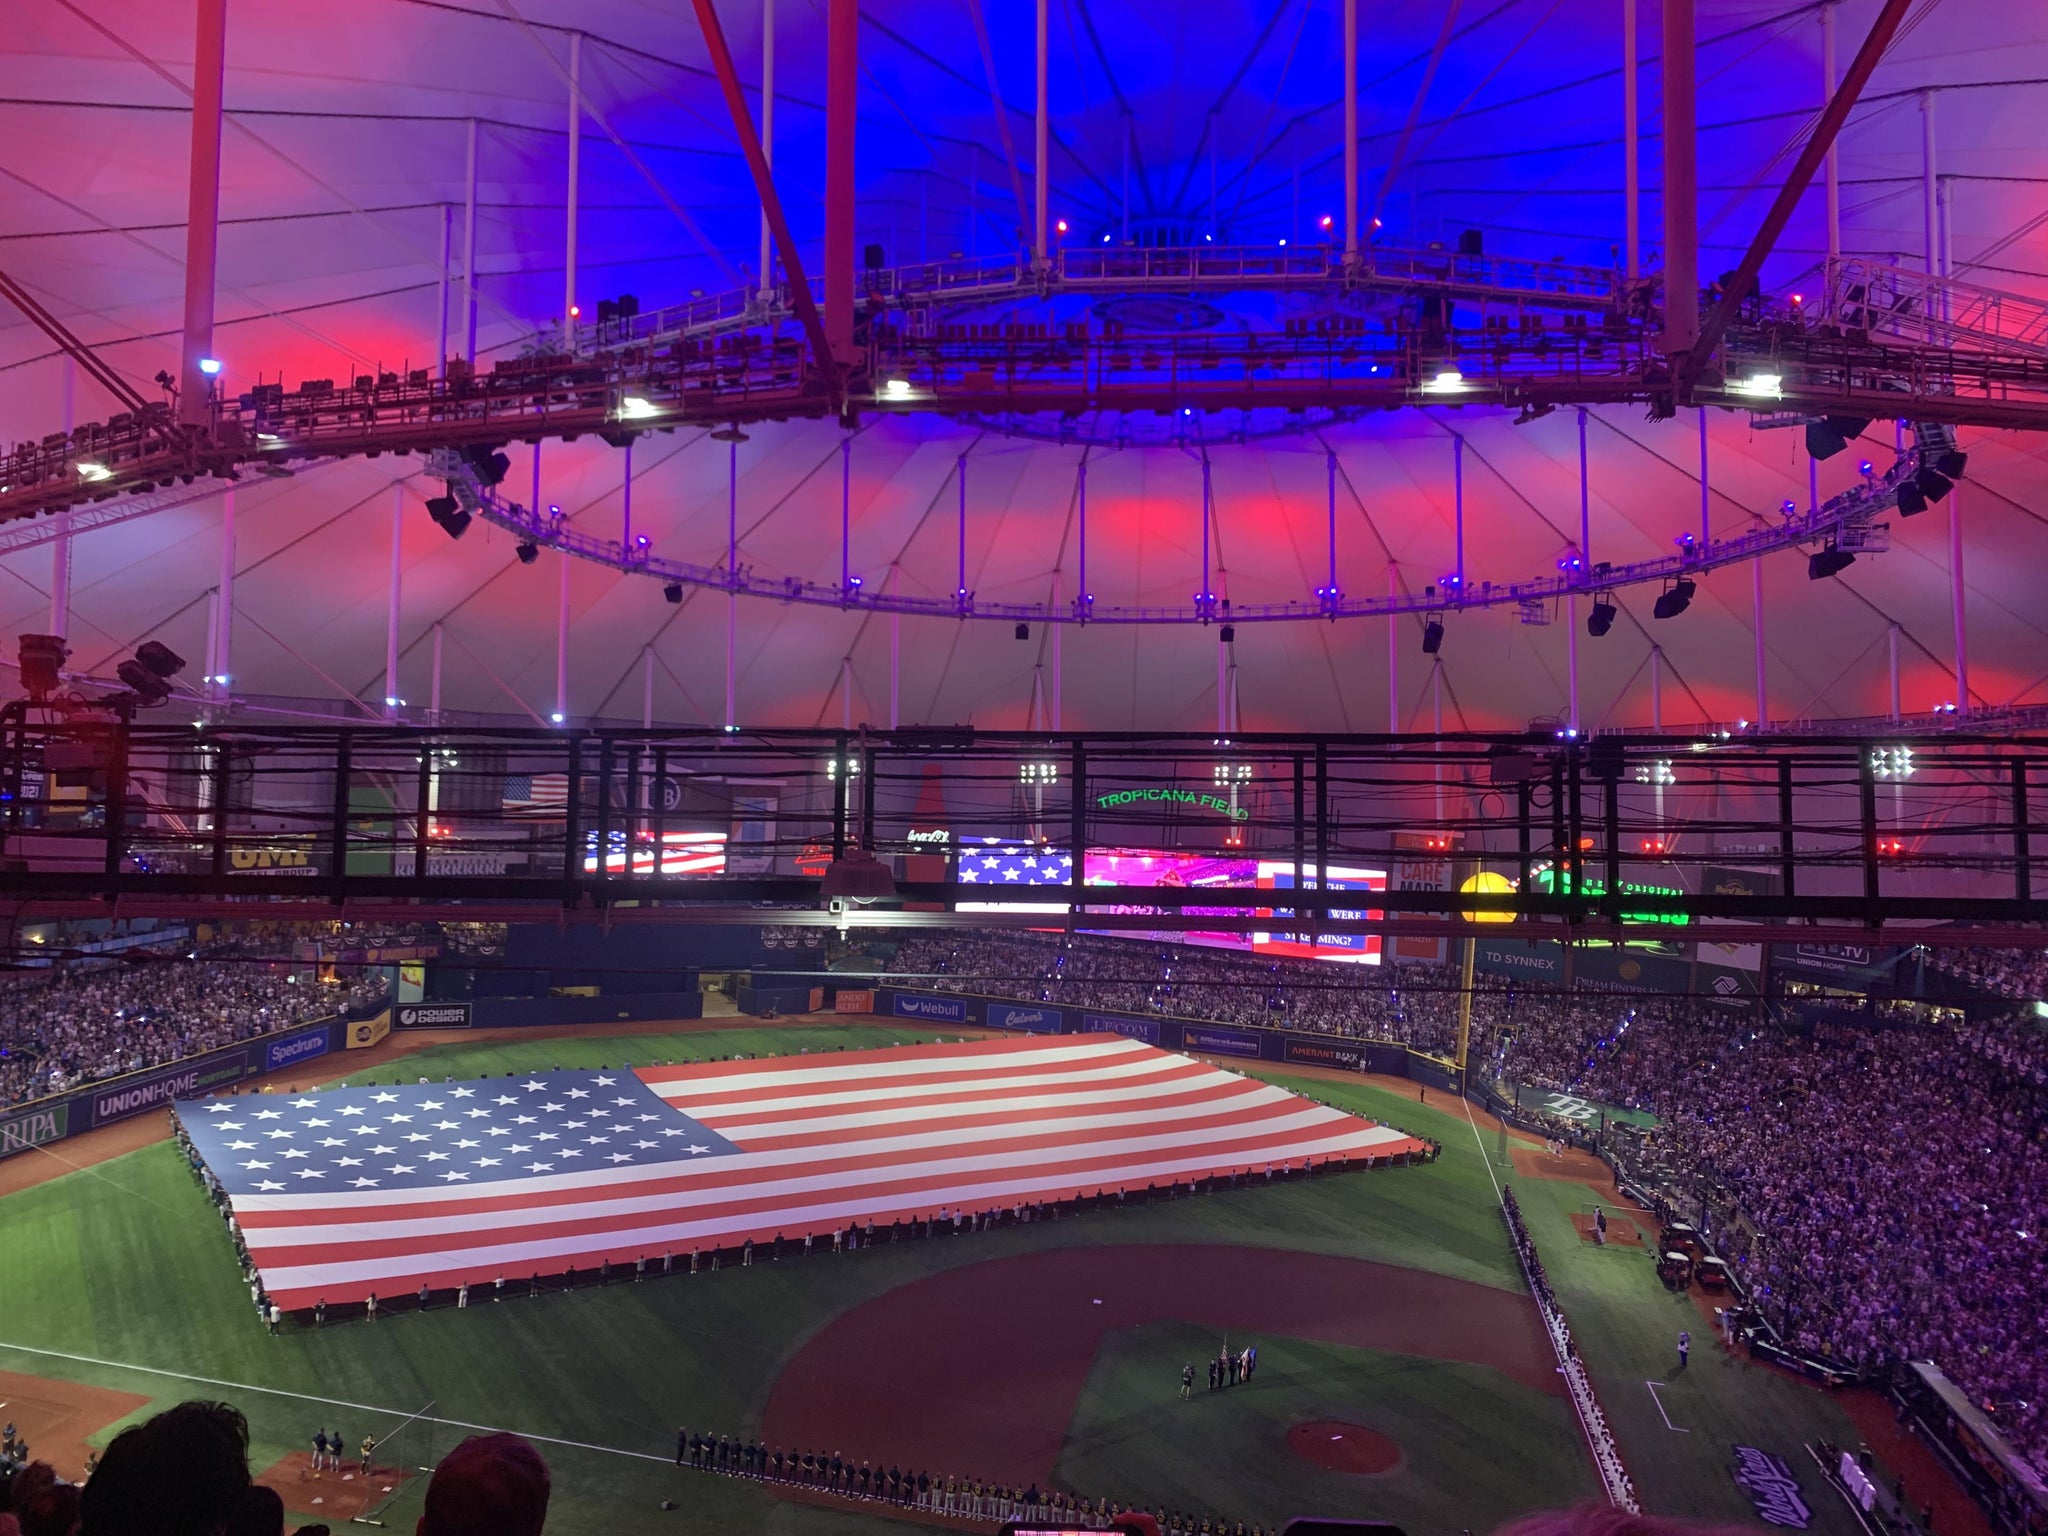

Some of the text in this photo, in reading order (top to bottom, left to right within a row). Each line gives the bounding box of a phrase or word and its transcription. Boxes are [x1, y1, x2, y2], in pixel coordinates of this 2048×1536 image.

[1098, 789, 1248, 820] TROPICANA FIELD
[1401, 863, 1444, 882] CARE
[1486, 951, 1554, 970] TD SYNNEX
[1796, 958, 1823, 968] UNION
[1823, 963, 1847, 972] HOME
[920, 1002, 959, 1017] Webull
[271, 1036, 320, 1062] Spectrum
[1292, 1046, 1335, 1059] AMERANT
[1543, 1092, 1598, 1119] TB
[1, 1111, 59, 1153] RIPA
